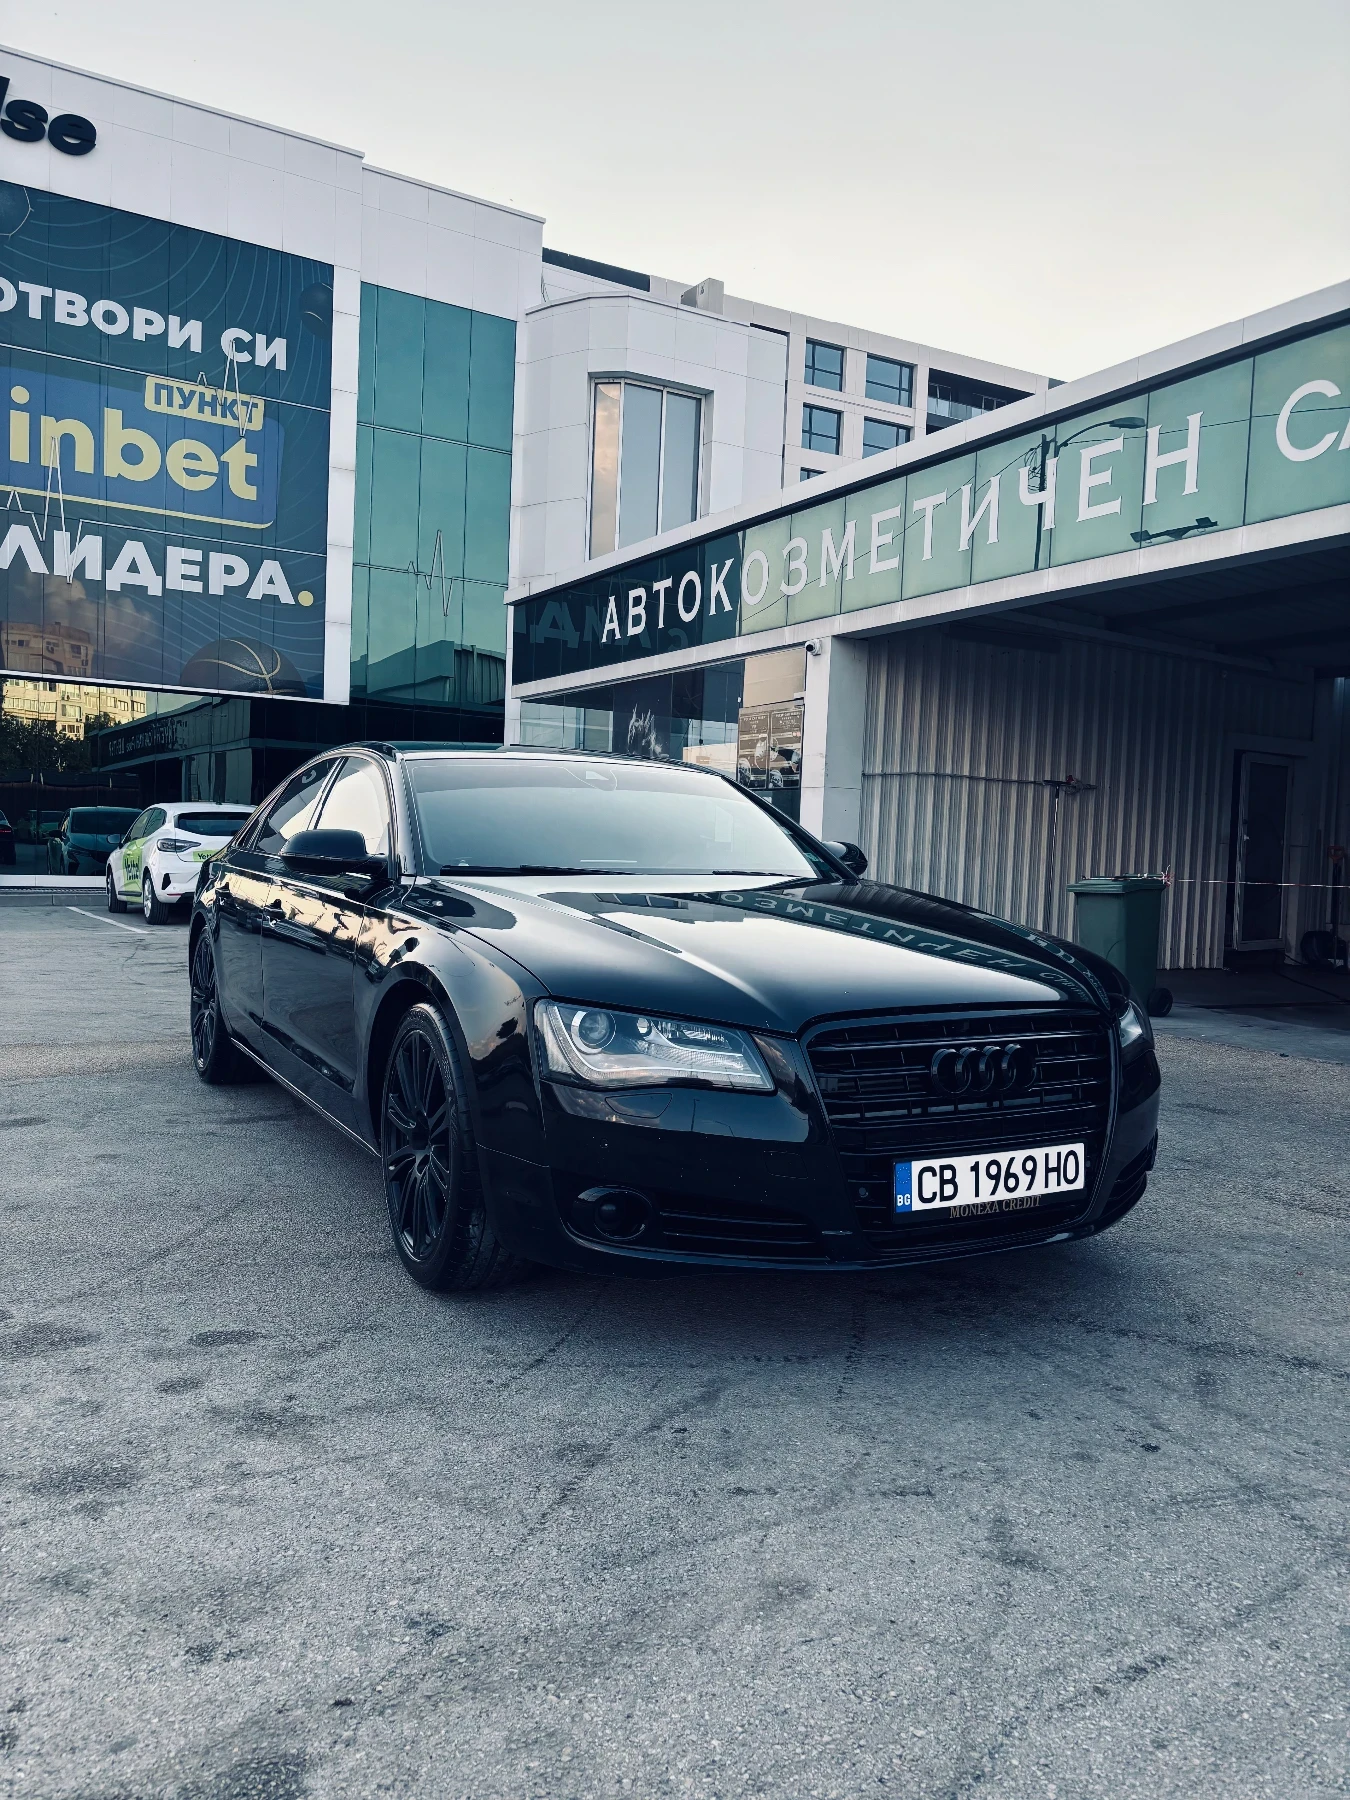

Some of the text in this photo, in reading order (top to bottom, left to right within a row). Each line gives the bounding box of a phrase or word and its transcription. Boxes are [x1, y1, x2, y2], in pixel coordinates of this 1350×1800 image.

[221, 328, 287, 371] СИ
[154, 382, 258, 424] ПУНКТ
[9, 385, 258, 501] inbet
[600, 411, 1204, 644] АВТОКОЗМЕТИЧЕН
[970, 1155, 1038, 1198] 1969
[897, 1194, 911, 1206] BG
[949, 1194, 1042, 1219] MONEXA CREDIT
